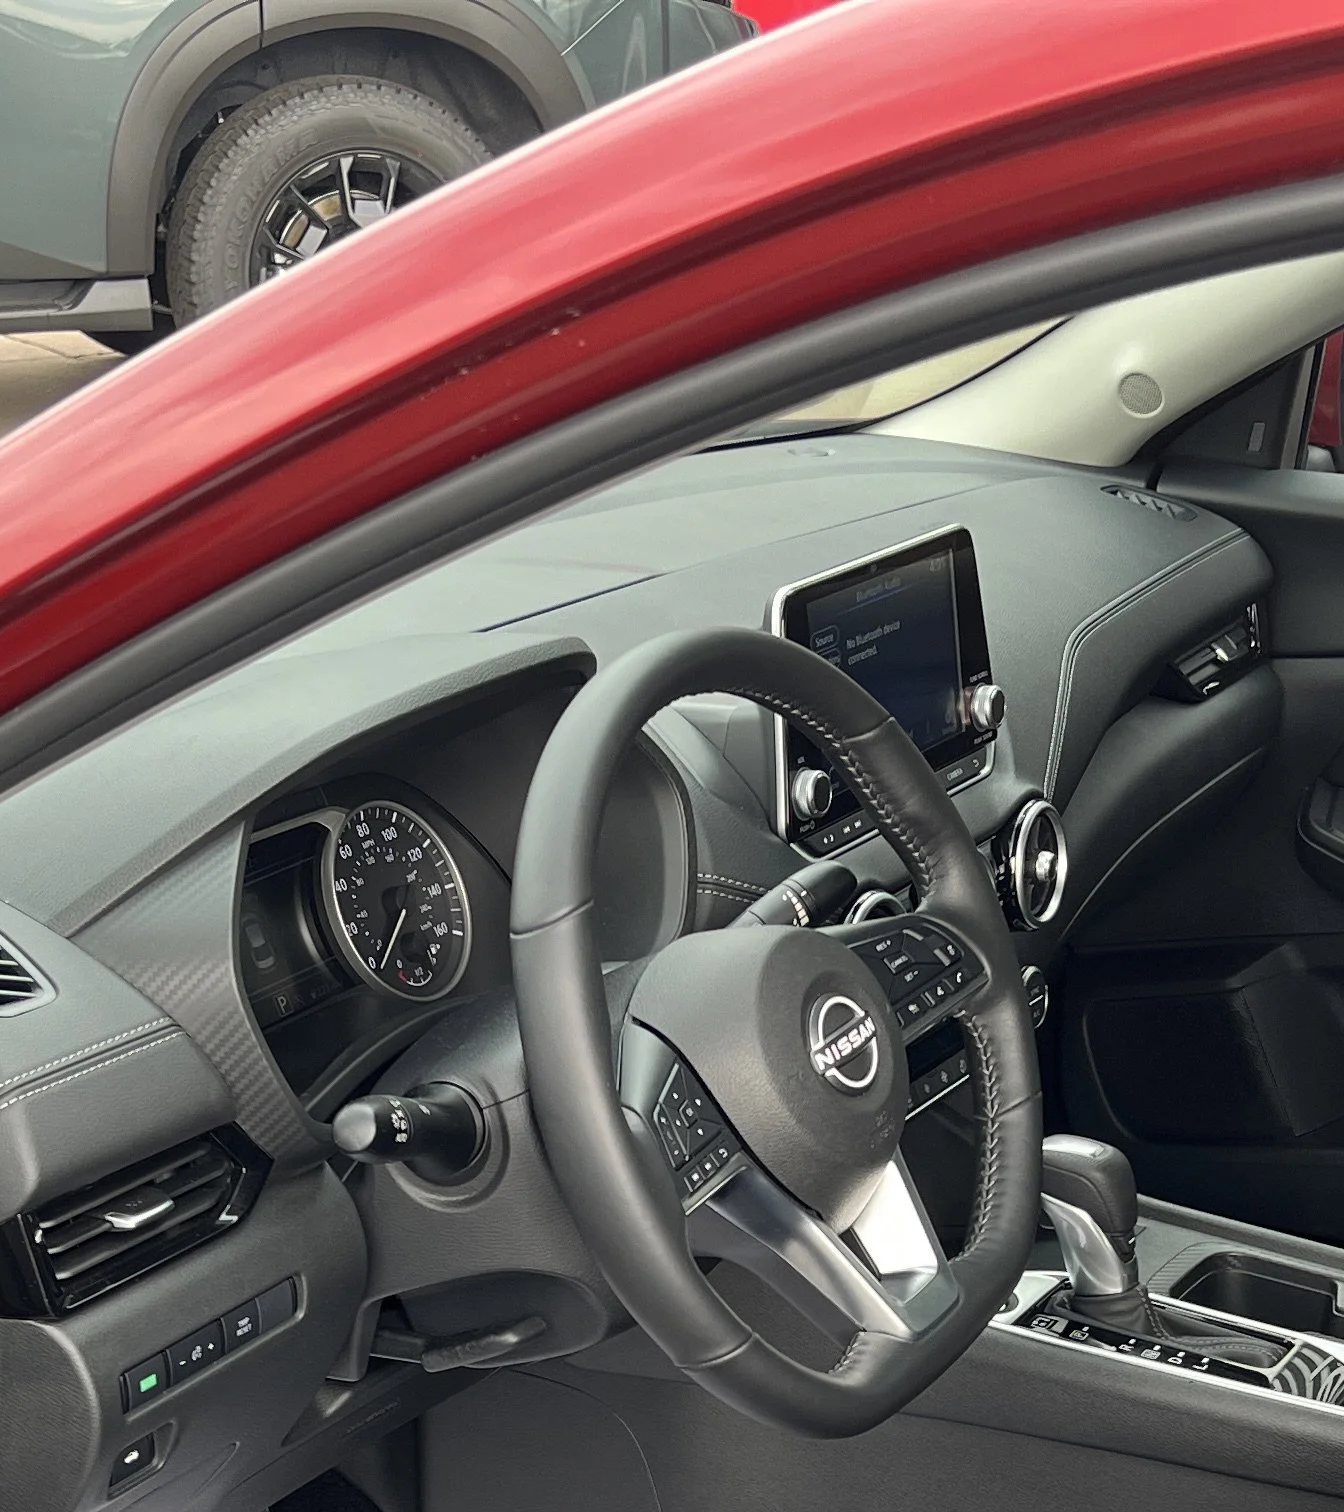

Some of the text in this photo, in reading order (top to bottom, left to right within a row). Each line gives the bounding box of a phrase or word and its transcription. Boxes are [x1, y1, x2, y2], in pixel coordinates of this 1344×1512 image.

[356, 822, 370, 838] 80
[381, 826, 398, 842] 100
[339, 844, 353, 860] 60
[407, 847, 423, 862] 120
[335, 878, 348, 893] 40
[427, 883, 442, 898] 140
[433, 921, 449, 938] 160
[368, 956, 377, 970] 0
[276, 995, 288, 1014] P
[814, 1016, 876, 1071] NISSAN
